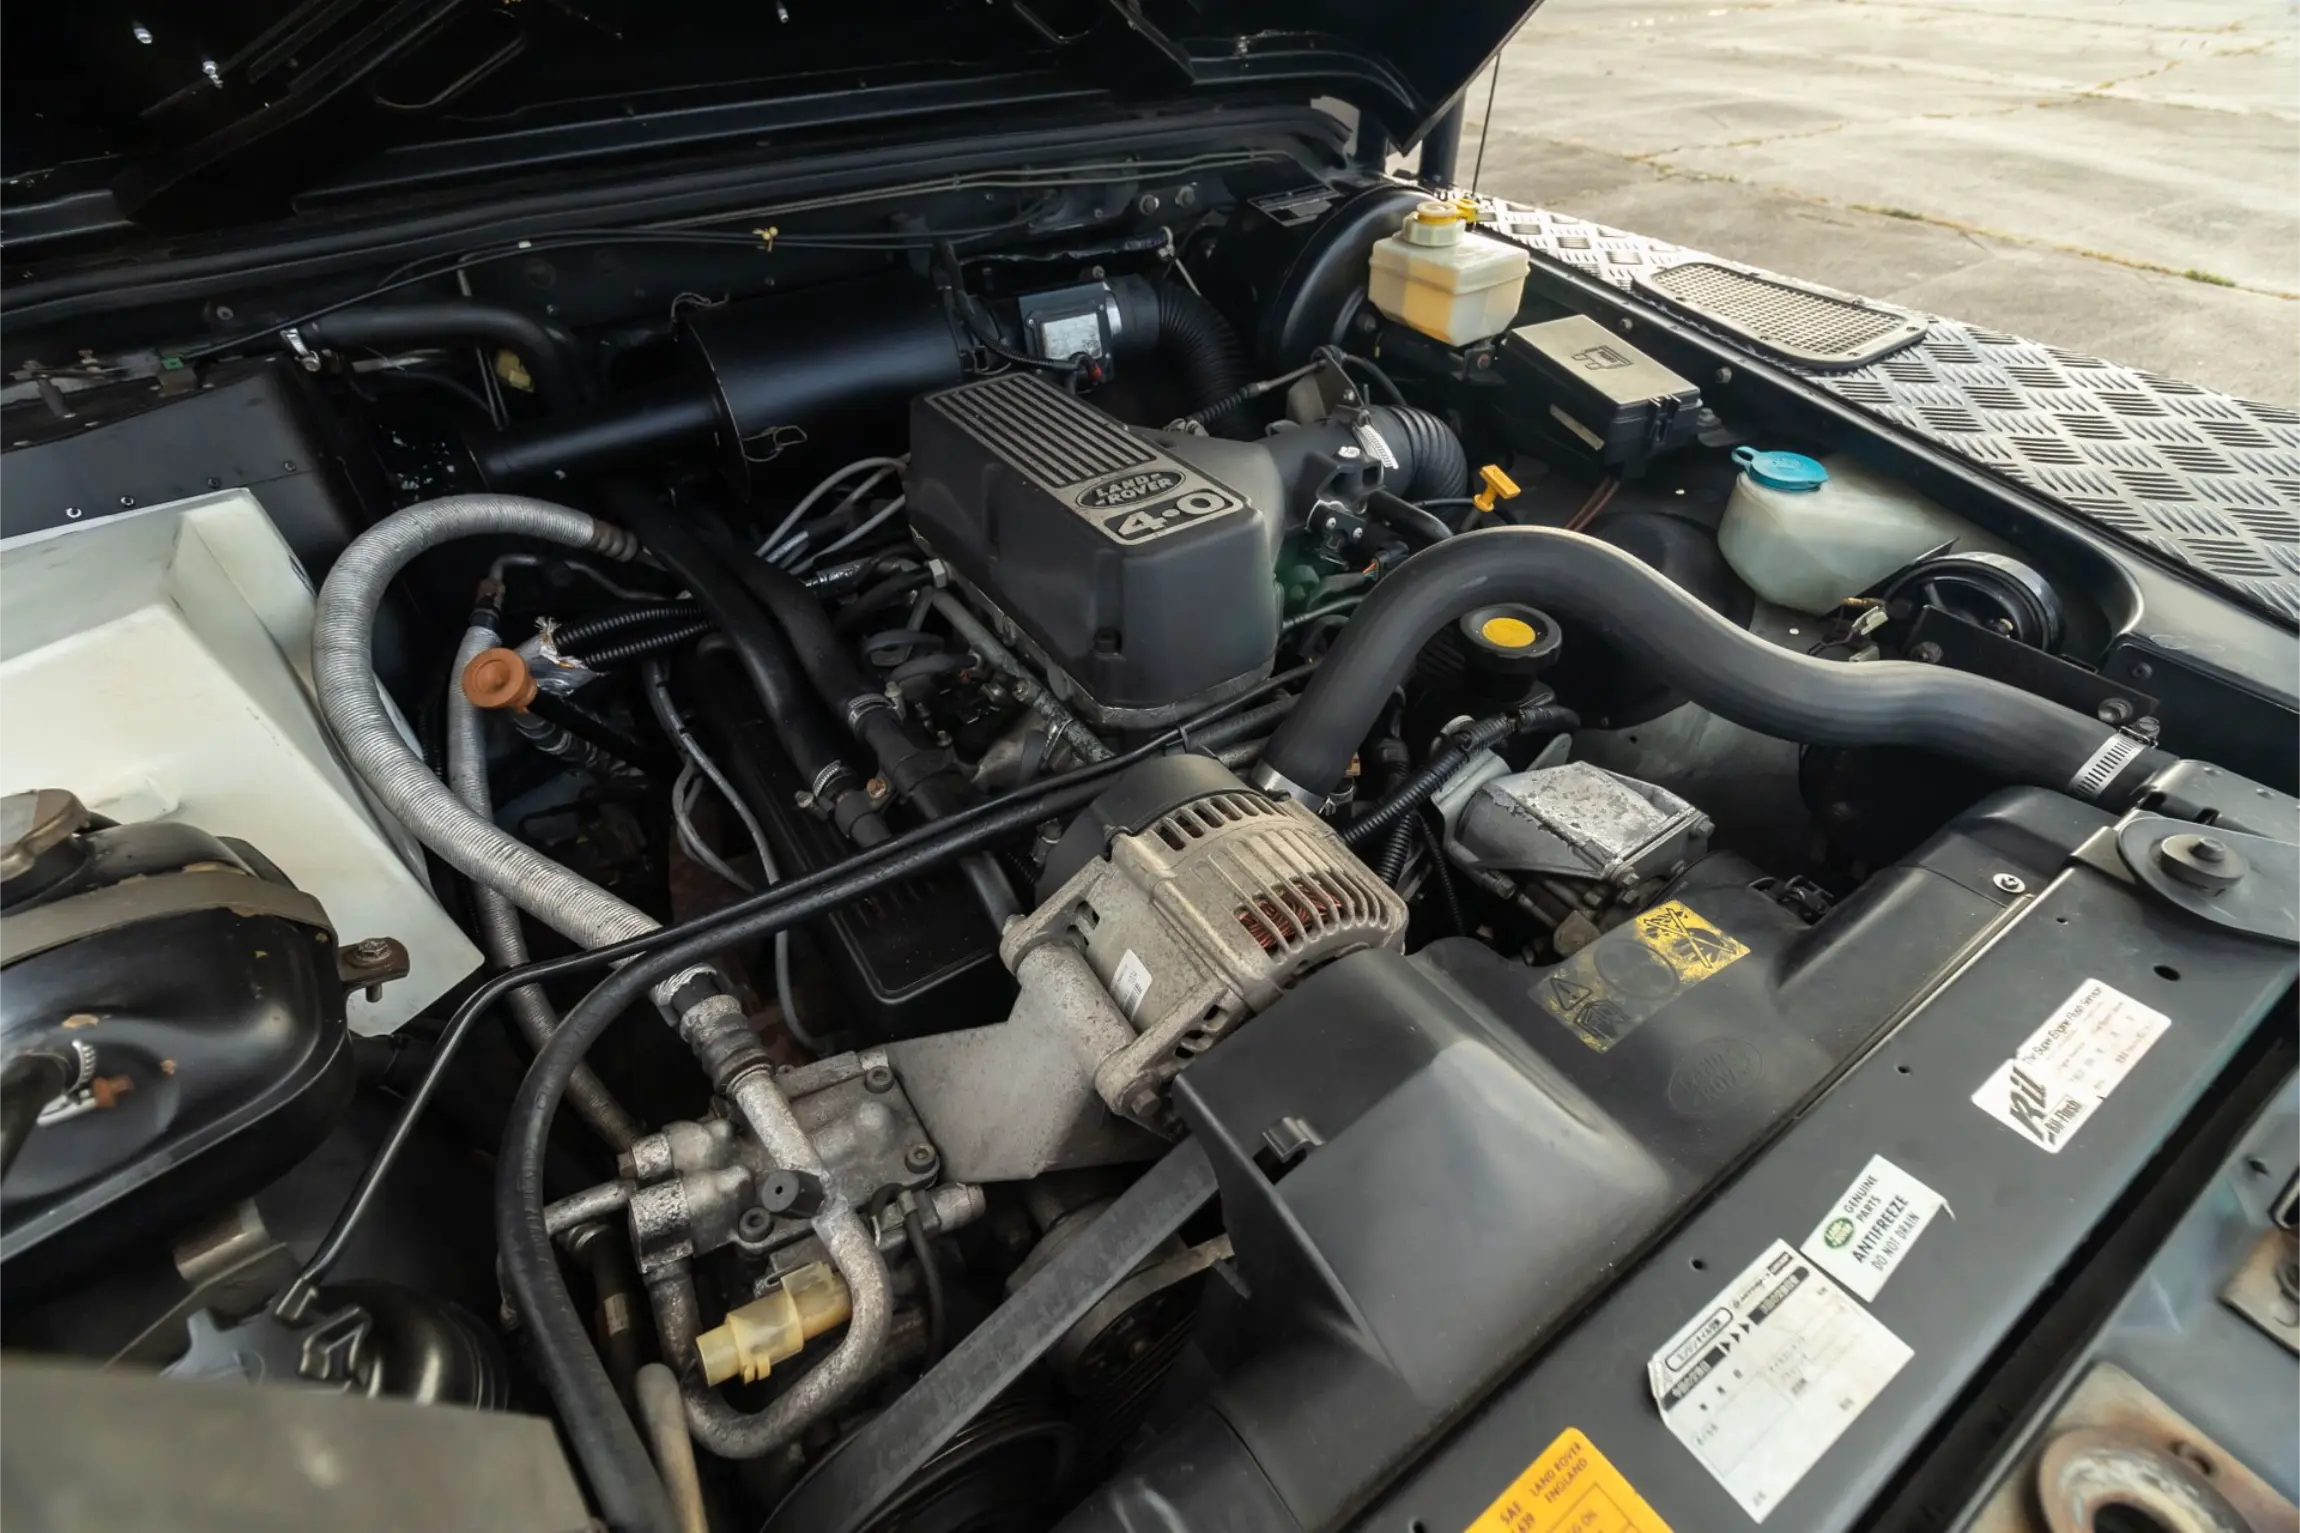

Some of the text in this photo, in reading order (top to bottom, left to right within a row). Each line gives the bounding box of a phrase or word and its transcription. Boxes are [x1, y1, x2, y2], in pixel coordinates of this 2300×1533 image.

[1095, 475, 1151, 498] LAND
[1108, 479, 1173, 503] ROVER
[2032, 1038, 2052, 1055] Super
[2048, 1019, 2070, 1039] Engine
[2066, 1005, 2084, 1020] Flush
[1843, 1174, 1878, 1214] GENUINE
[1856, 1195, 1882, 1223] PARTS
[1851, 1195, 1909, 1264] ANTIFREEZE
[1871, 1212, 1920, 1272] DO NOT DRAIN
[1530, 1442, 1581, 1496] LAND ROVER
[1544, 1458, 1587, 1503] ENGLAND
